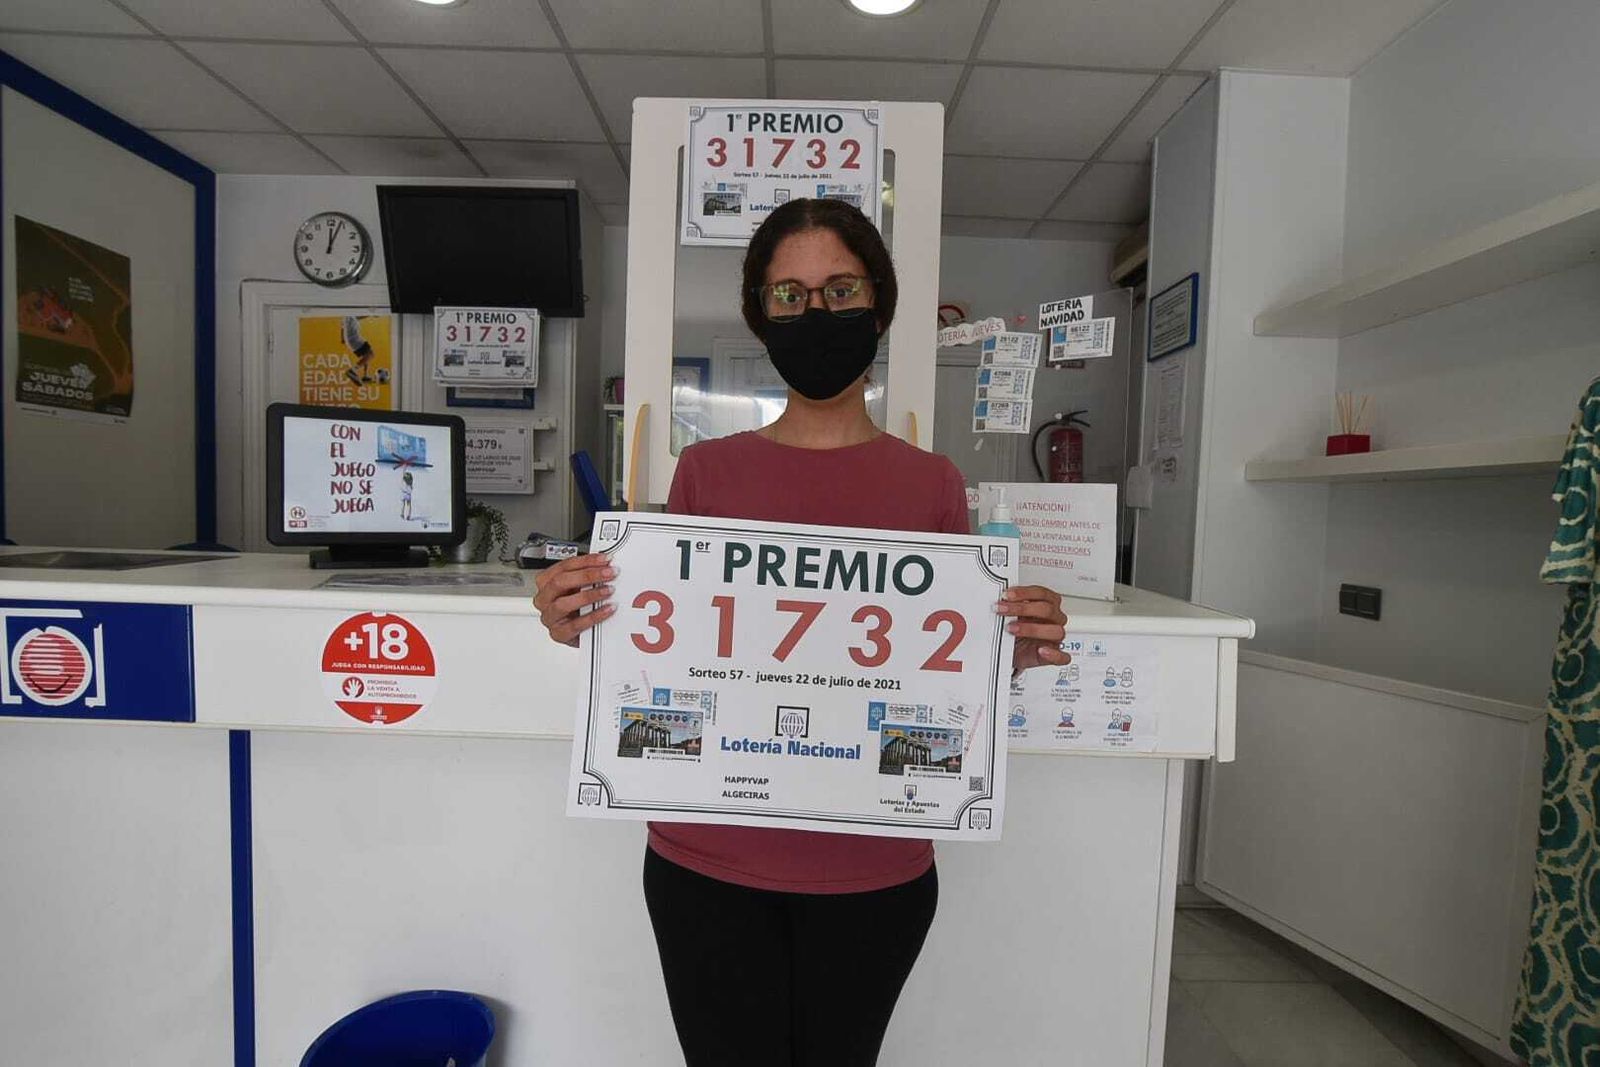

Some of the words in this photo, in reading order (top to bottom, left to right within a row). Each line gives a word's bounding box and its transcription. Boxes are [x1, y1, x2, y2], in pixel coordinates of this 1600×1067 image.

[748, 113, 844, 134] PREMIO
[348, 231, 357, 240] 2
[300, 245, 309, 253] 9
[352, 245, 360, 253] 3
[314, 268, 321, 276] 7
[326, 271, 334, 279] 6
[1041, 298, 1083, 314] LOTERIA
[467, 312, 517, 324] PREMIO
[1040, 309, 1085, 327] NAVIDAD
[937, 329, 967, 342] OTERIA
[303, 353, 352, 369] CADA
[303, 369, 350, 385] EDAD
[303, 386, 353, 401] TIENE
[358, 386, 379, 401] SU
[330, 423, 361, 441] CON
[330, 442, 347, 458] EL
[466, 439, 498, 450] 4.379
[331, 461, 376, 478] JUEGO
[330, 479, 353, 496] NO
[358, 479, 373, 495] SE
[331, 497, 375, 515] JUEGA
[967, 494, 979, 503] DO
[1069, 521, 1090, 530] ANTES
[1091, 522, 1101, 530] DE
[723, 541, 935, 597] PREMIO
[344, 622, 409, 661] +18
[368, 663, 426, 672] RESPONSABILIDAD
[688, 666, 727, 681] Sorteo
[729, 669, 744, 681] 57
[755, 670, 793, 686] jueves
[795, 674, 810, 685] 22
[812, 674, 827, 687] de
[828, 675, 855, 689] julio
[857, 677, 872, 689] de
[873, 678, 902, 691] 2021
[720, 736, 782, 756] Lotería
[787, 740, 861, 760] Nacional
[724, 775, 770, 787] HAPPYVAP
[721, 790, 771, 801] ALGECIRAS
